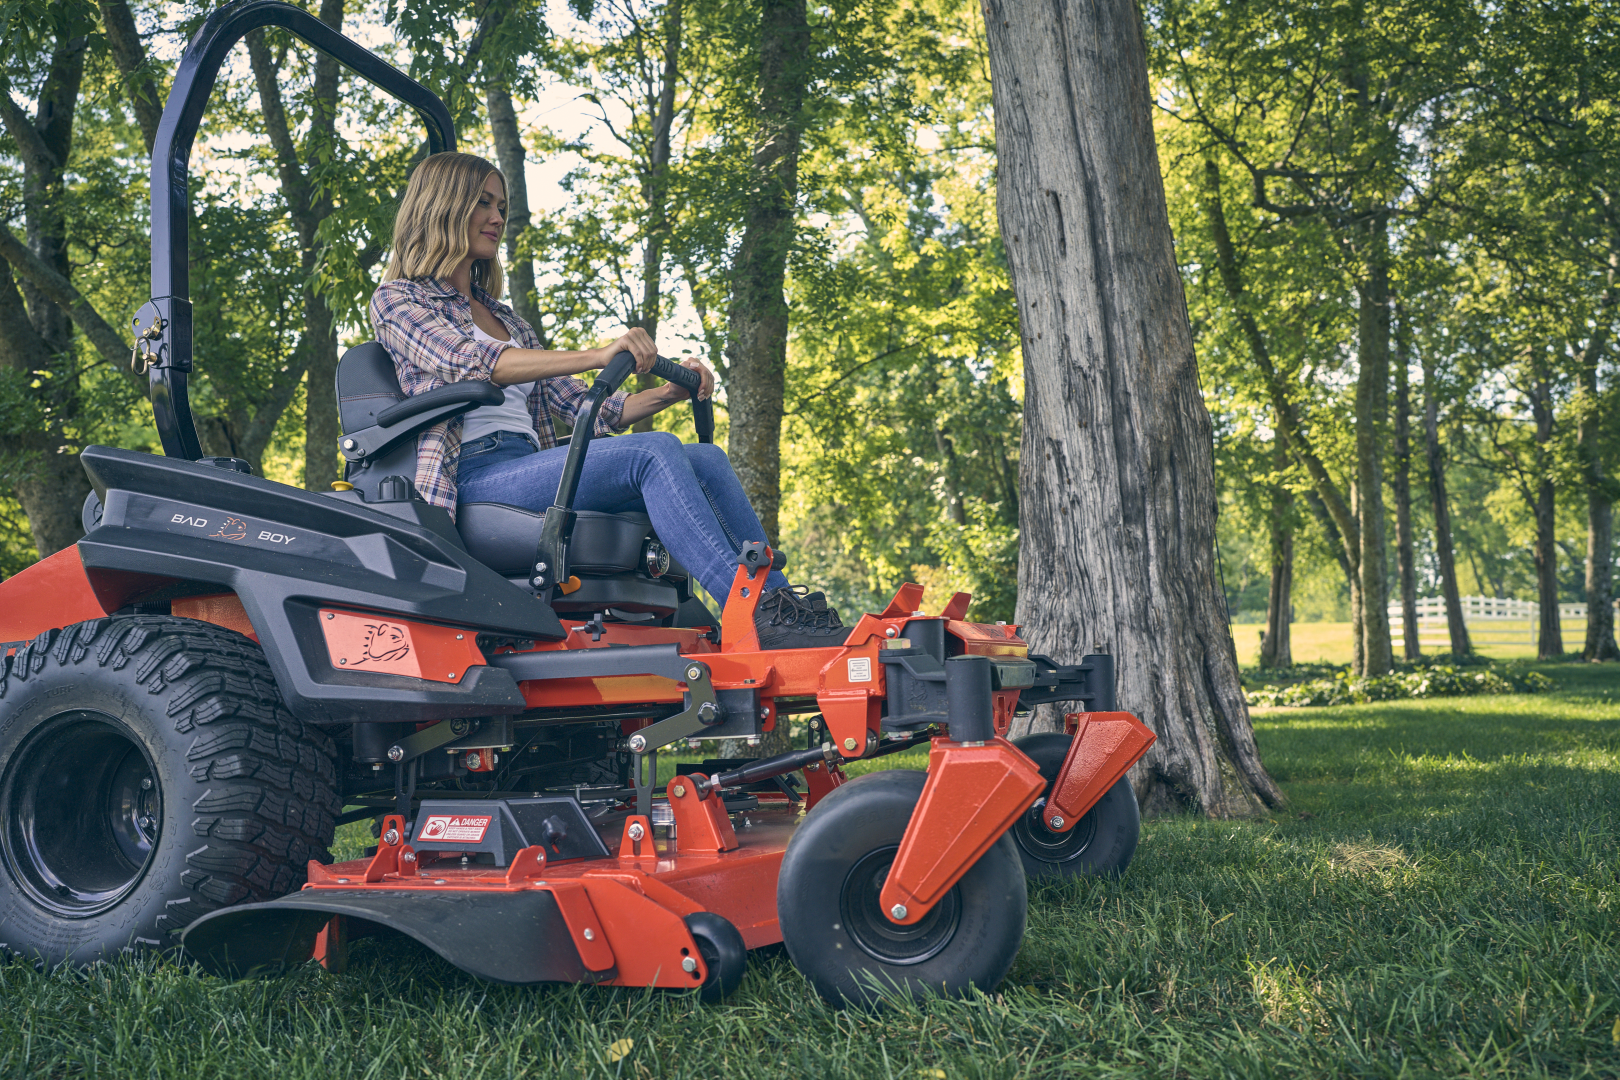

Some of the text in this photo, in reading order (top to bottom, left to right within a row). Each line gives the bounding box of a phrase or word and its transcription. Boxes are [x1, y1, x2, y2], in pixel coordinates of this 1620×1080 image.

[171, 513, 296, 545] BAD BOY
[43, 684, 75, 699] TURF
[461, 818, 488, 826] DANGER
